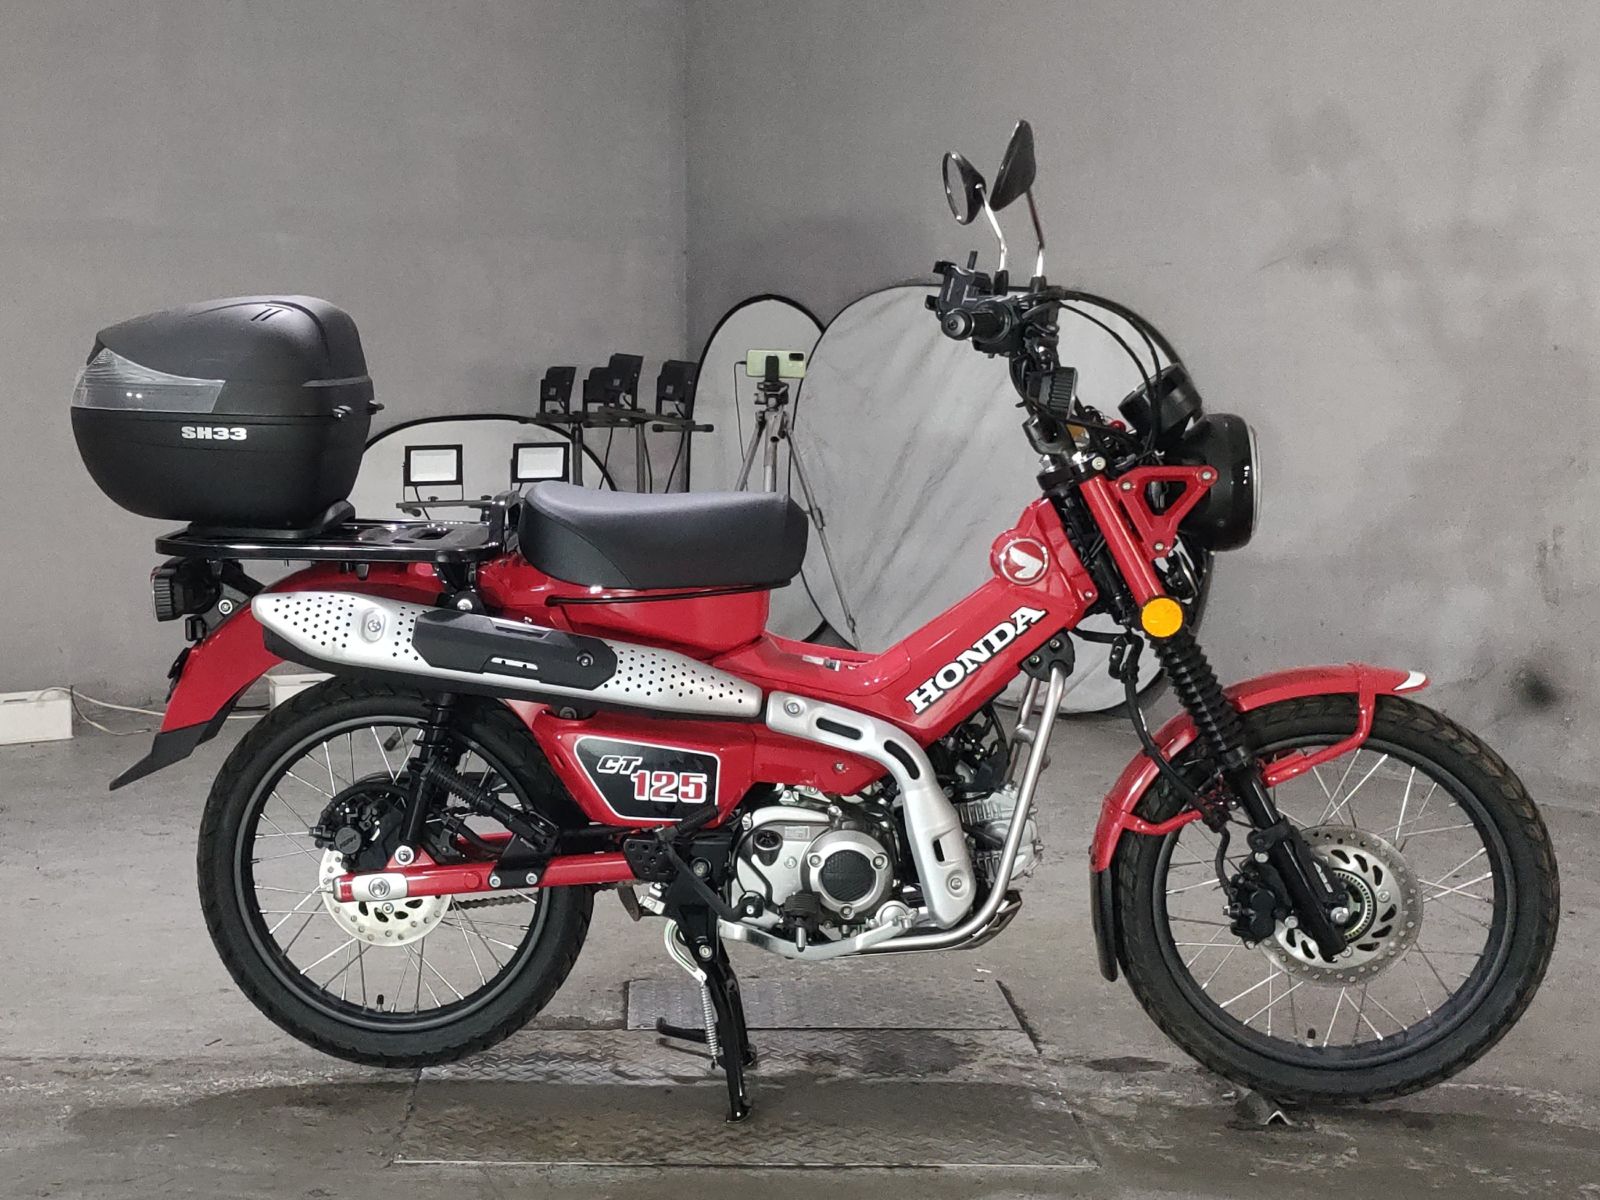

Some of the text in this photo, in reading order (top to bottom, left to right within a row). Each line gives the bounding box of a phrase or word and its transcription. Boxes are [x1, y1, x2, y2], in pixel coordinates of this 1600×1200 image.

[181, 426, 248, 441] SH33
[905, 606, 1047, 714] HONDA
[597, 755, 643, 775] CT
[631, 770, 708, 804] 125
